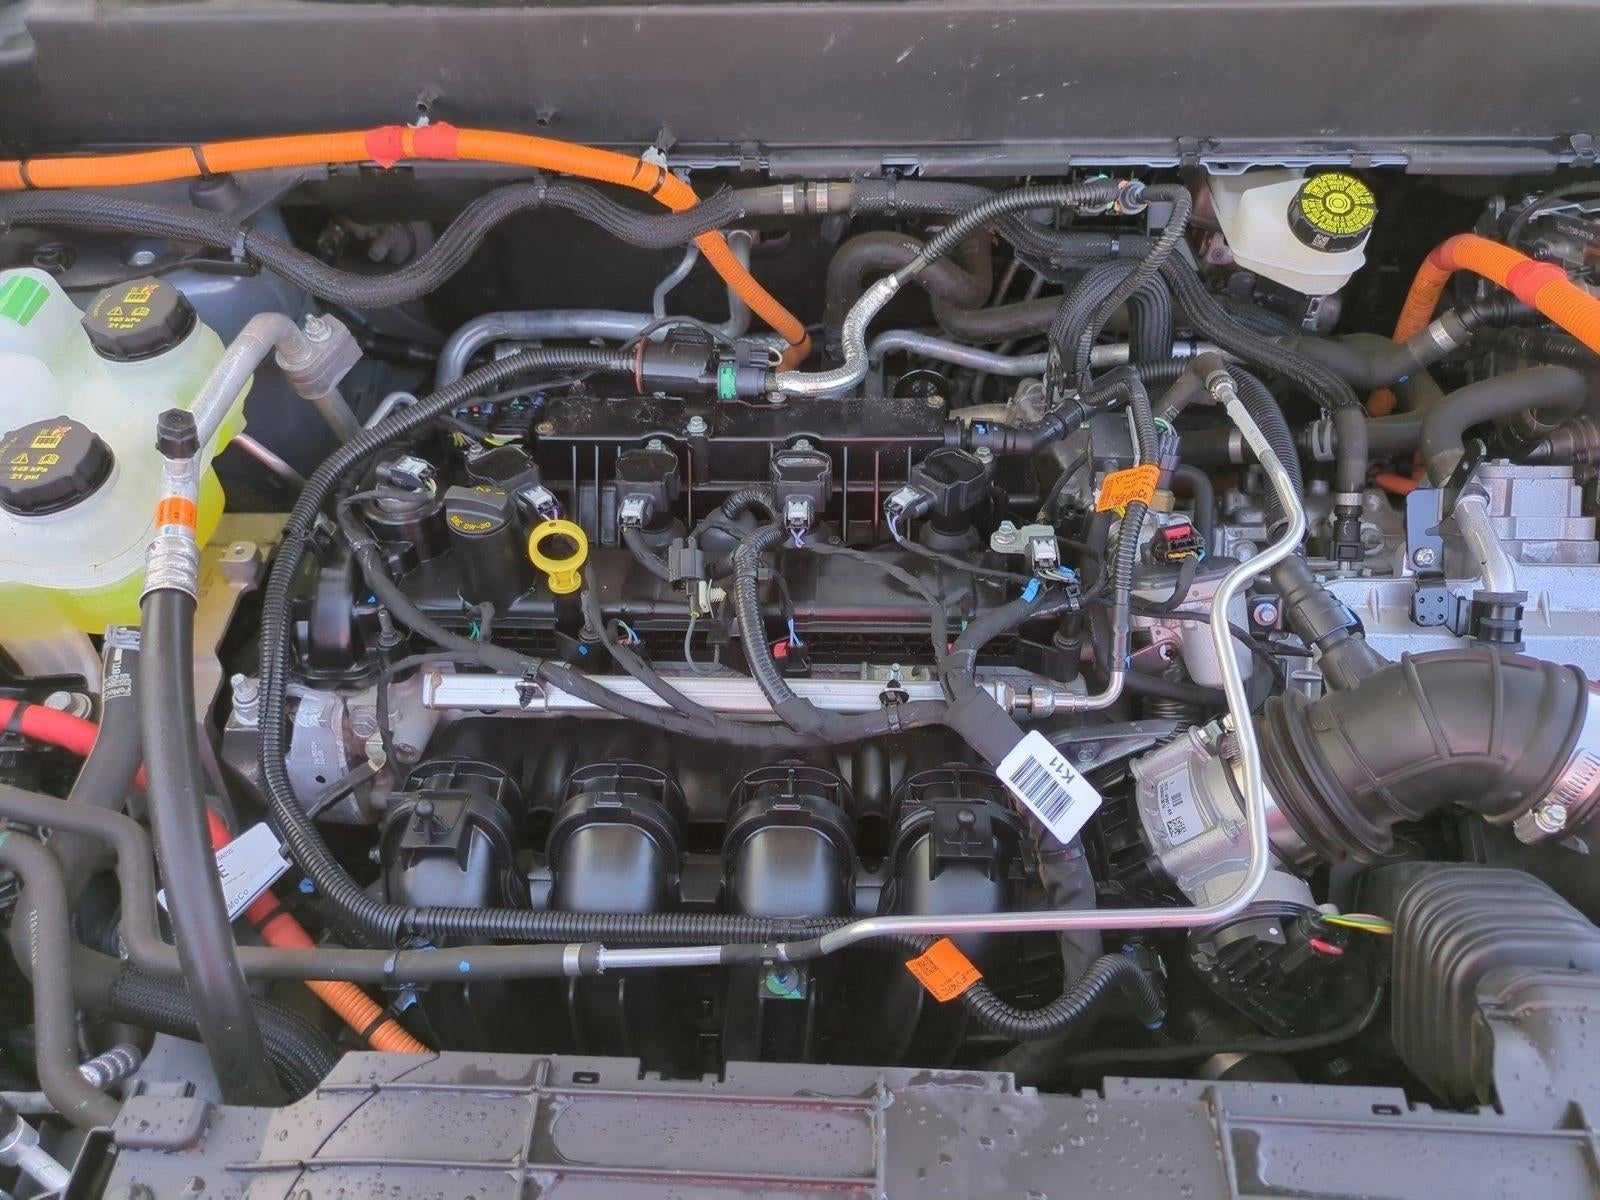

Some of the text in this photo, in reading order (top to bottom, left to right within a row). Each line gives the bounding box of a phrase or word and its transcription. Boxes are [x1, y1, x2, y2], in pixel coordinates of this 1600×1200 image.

[30, 465, 48, 473] kPa
[24, 473, 40, 481] psi
[450, 515, 463, 527] SAE
[1049, 756, 1075, 784] K11
[228, 889, 249, 911] MoCo
